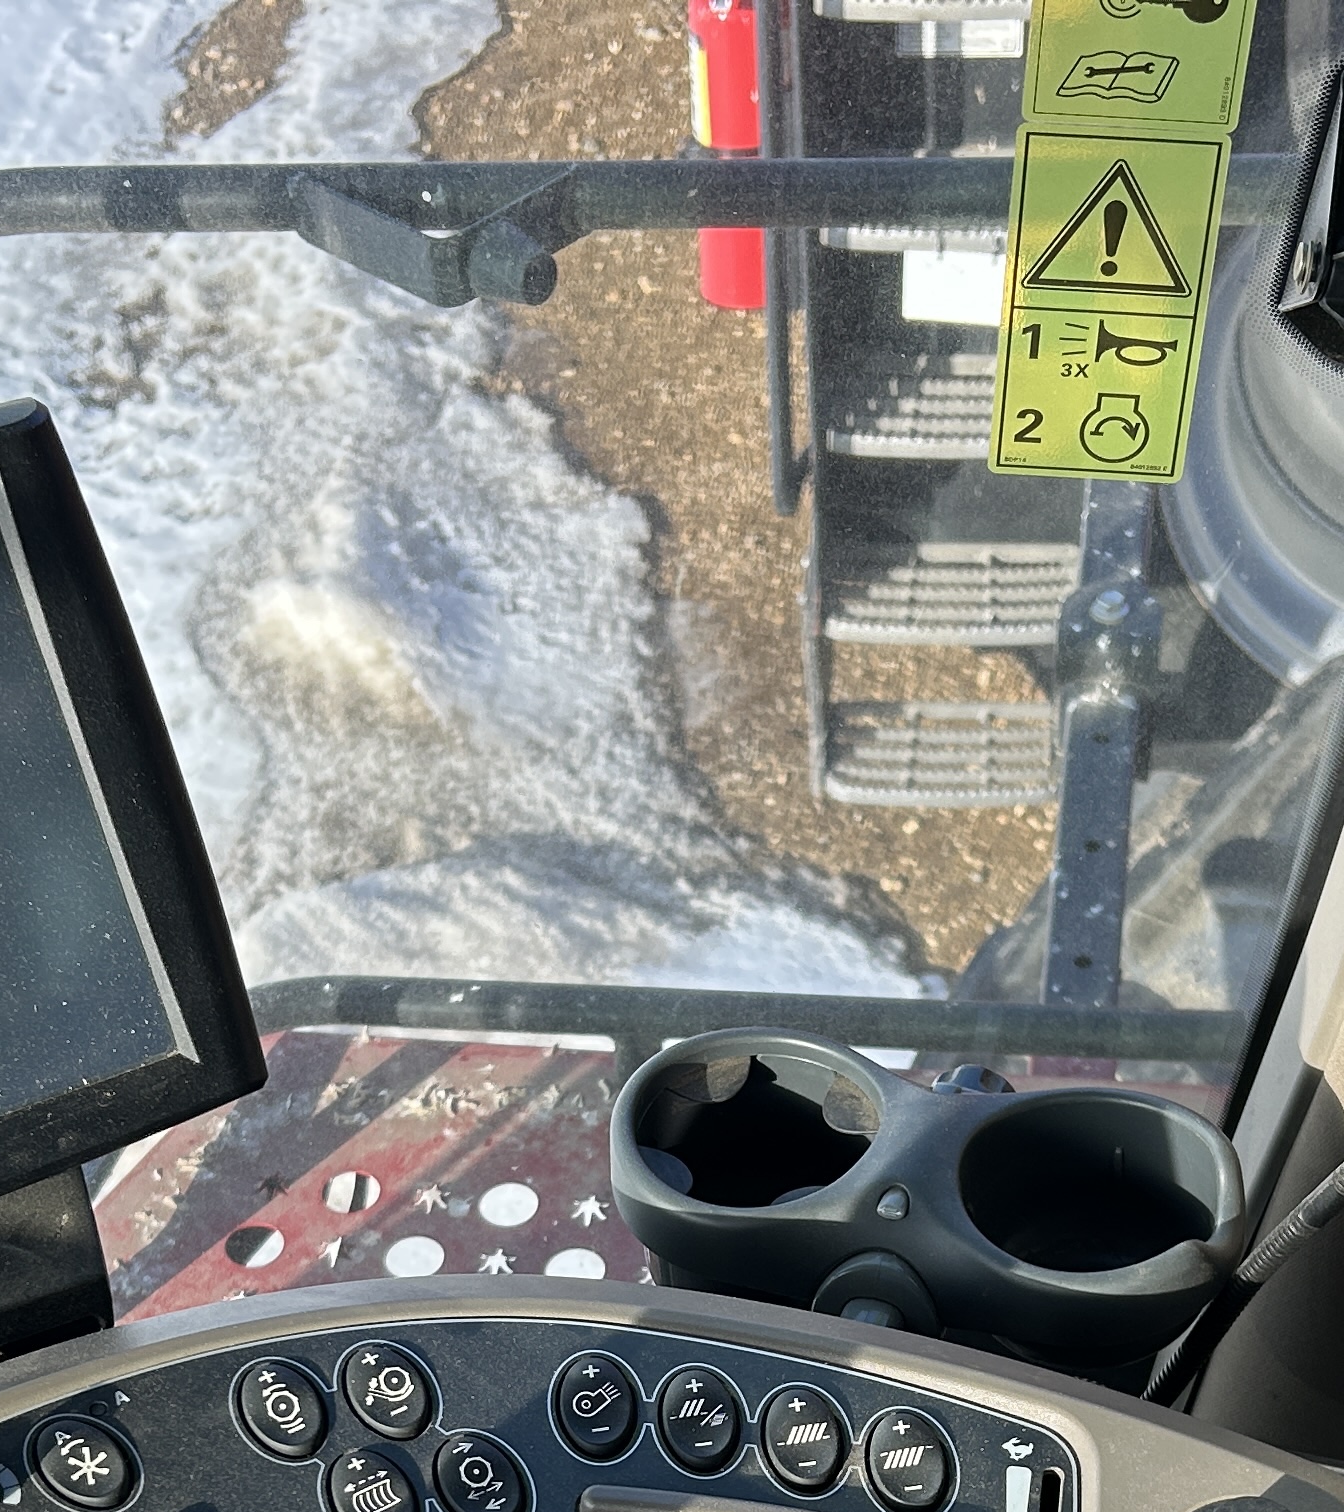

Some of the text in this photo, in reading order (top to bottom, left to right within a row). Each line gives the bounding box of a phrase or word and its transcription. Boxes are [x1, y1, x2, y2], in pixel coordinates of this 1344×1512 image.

[1022, 324, 1041, 359] 1
[1061, 363, 1089, 378] 3X
[1014, 408, 1044, 443] 2
[115, 1390, 131, 1406] A
[55, 1431, 71, 1446] A
